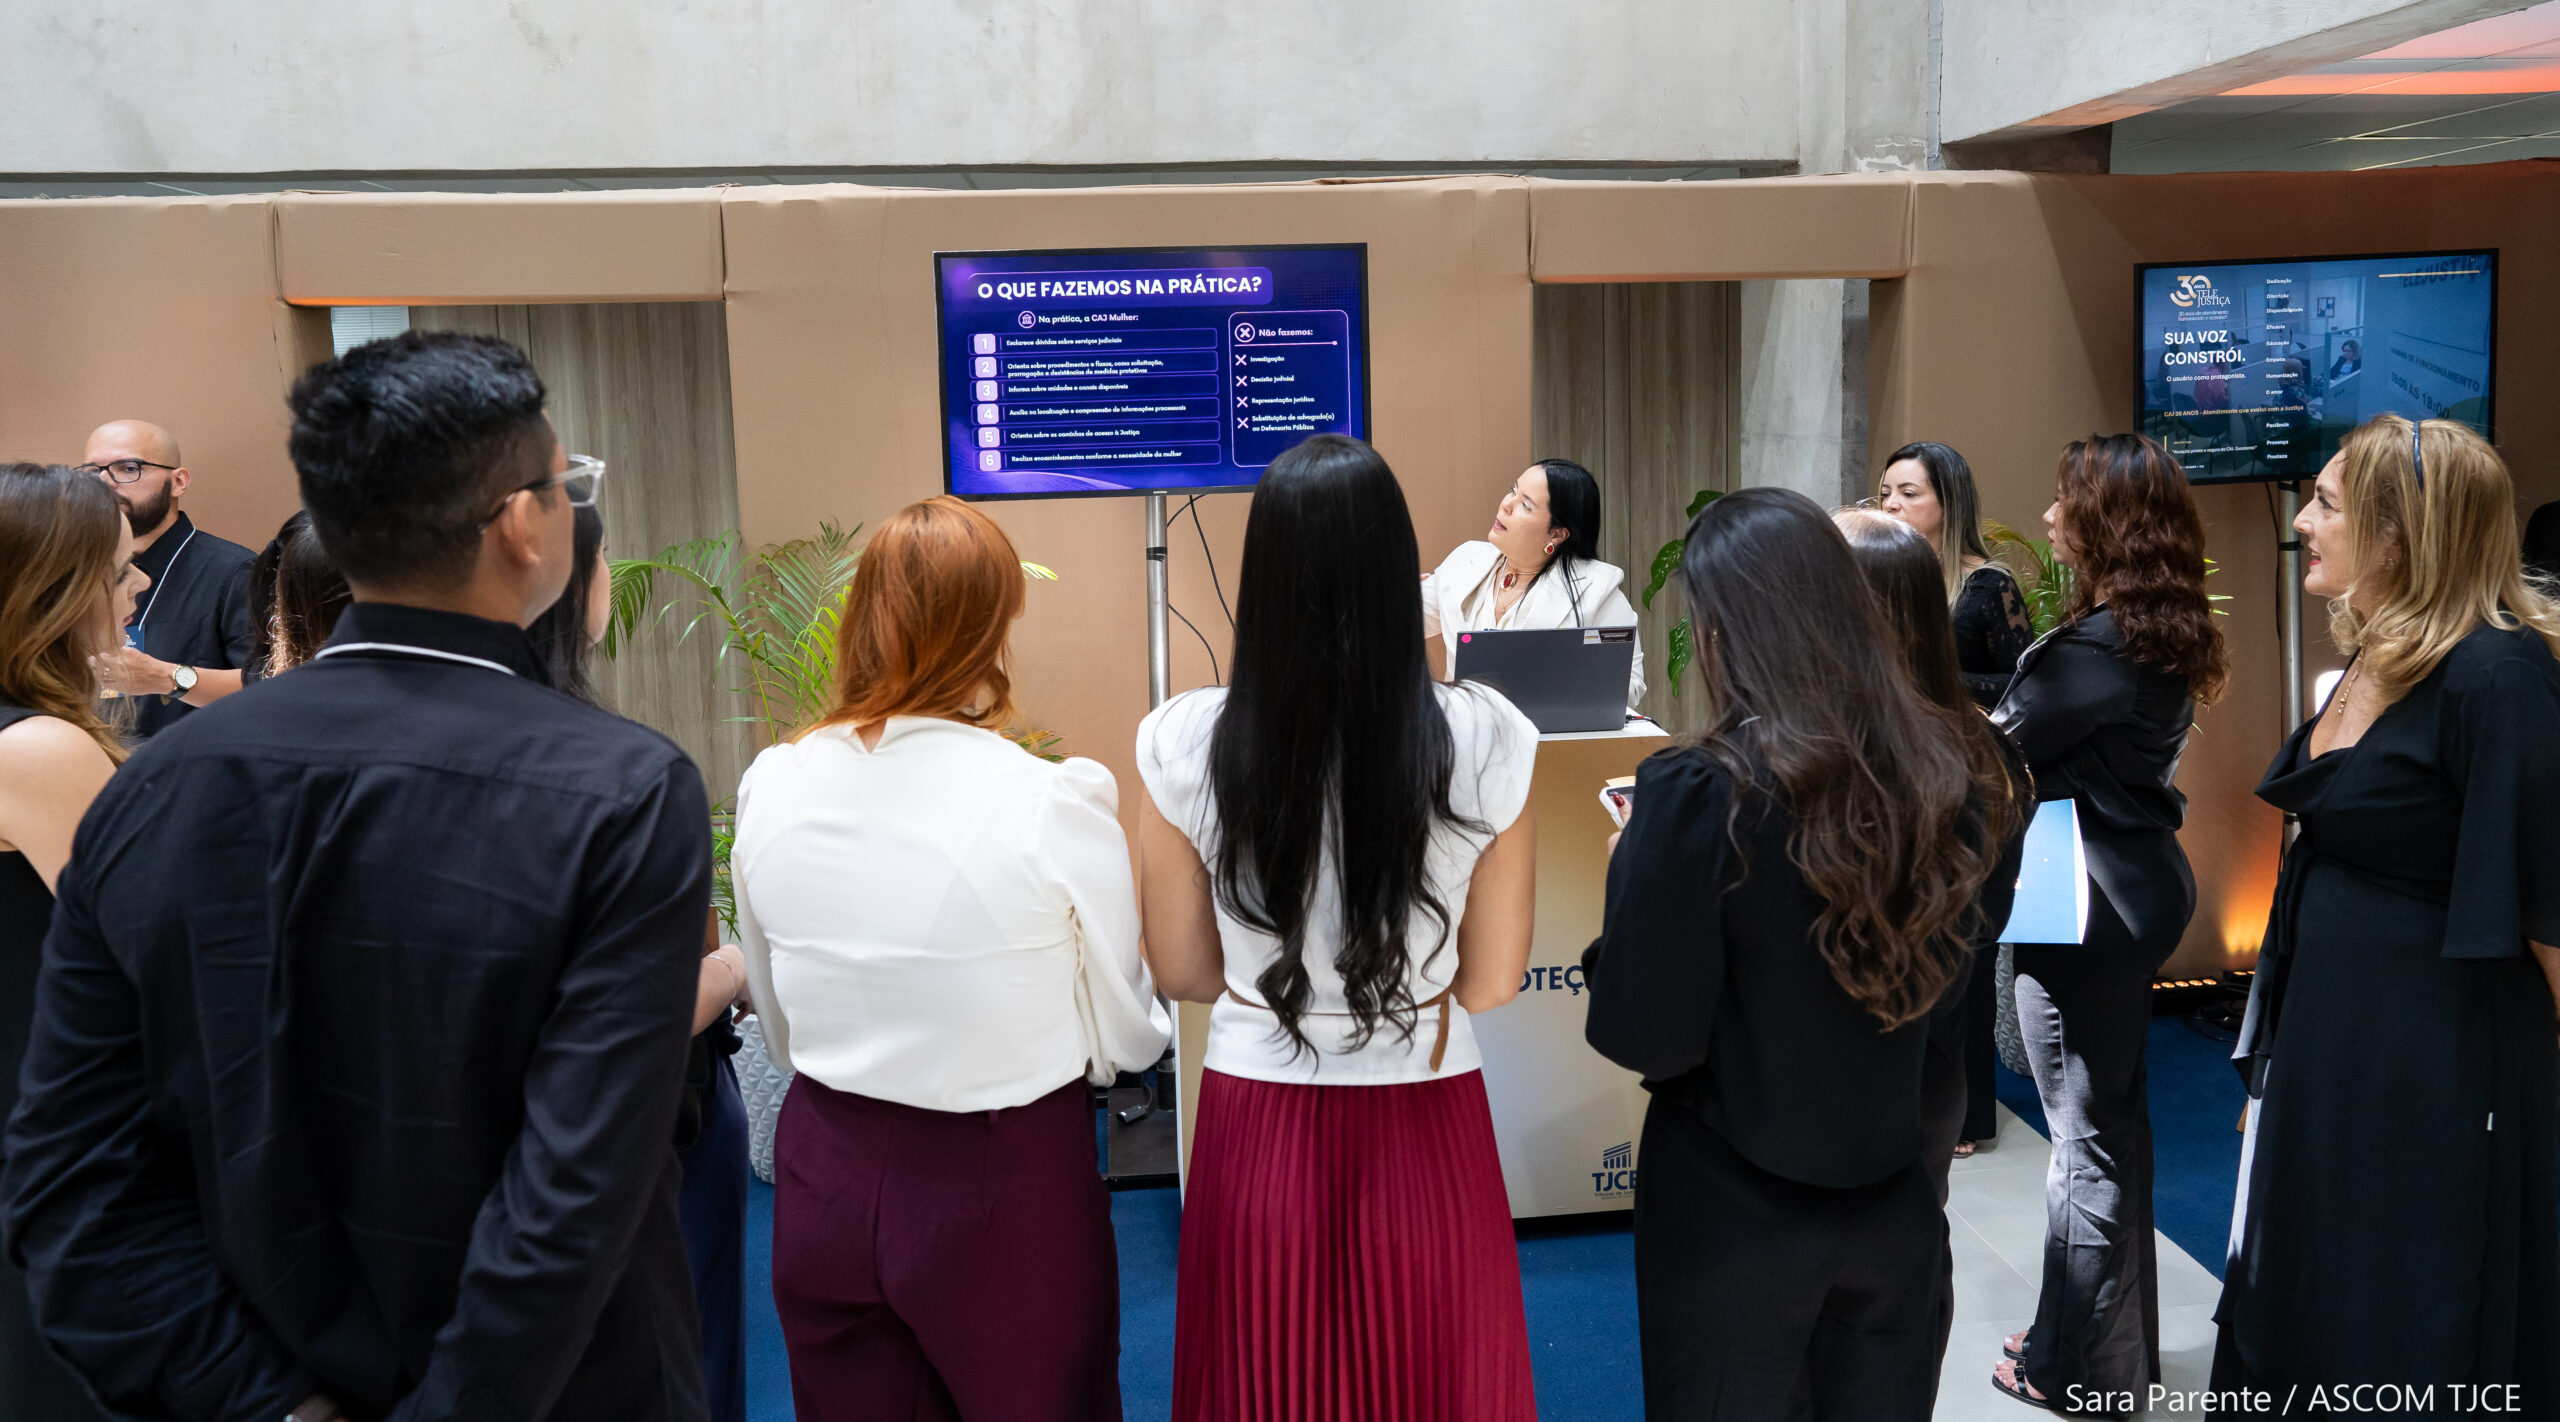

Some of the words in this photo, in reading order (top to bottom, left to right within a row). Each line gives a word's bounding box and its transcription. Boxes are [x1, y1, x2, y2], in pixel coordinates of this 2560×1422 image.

[978, 283, 993, 298] O
[997, 282, 1037, 300] QUE
[1041, 280, 1132, 297] FAZEMOS
[1136, 279, 1164, 295] NA
[1168, 273, 1262, 294] PRÁTICA?
[2197, 289, 2218, 298] TELE
[2197, 296, 2231, 308] JUSTIÇA
[1038, 315, 1050, 323] Na
[1052, 315, 1082, 325] prática,
[1109, 313, 1139, 321] Mulher:
[1258, 329, 1277, 337] Não
[1278, 328, 1314, 336] fazemos:
[2164, 331, 2195, 345] SUA
[2197, 330, 2228, 344] VOZ
[981, 338, 988, 350] 1
[1035, 338, 1057, 346] dúvidas
[1098, 337, 1122, 345] judiciais
[2164, 347, 2246, 365] CONSTRÓI.
[981, 361, 990, 373] 2
[1048, 361, 1090, 370] procedimentos
[1119, 368, 1148, 376] protetivas
[2210, 373, 2247, 381] protagonista.
[1273, 375, 1295, 383] judicial
[983, 385, 991, 396] 3
[1048, 384, 1073, 392] unidades
[1098, 383, 1129, 391] disponíveis
[1251, 397, 1293, 405] Representação
[1293, 396, 1315, 404] jurídica
[983, 408, 993, 420] 4
[1037, 408, 1070, 416] localização
[1121, 405, 1154, 413] informações
[1155, 405, 1187, 413] processuais
[1288, 413, 1296, 421] de
[1297, 412, 1335, 421] advogado(a)
[985, 432, 993, 443] 5
[1058, 430, 1085, 438] caminhos
[985, 454, 994, 466] 6
[1592, 1170, 1637, 1192] TJCE
